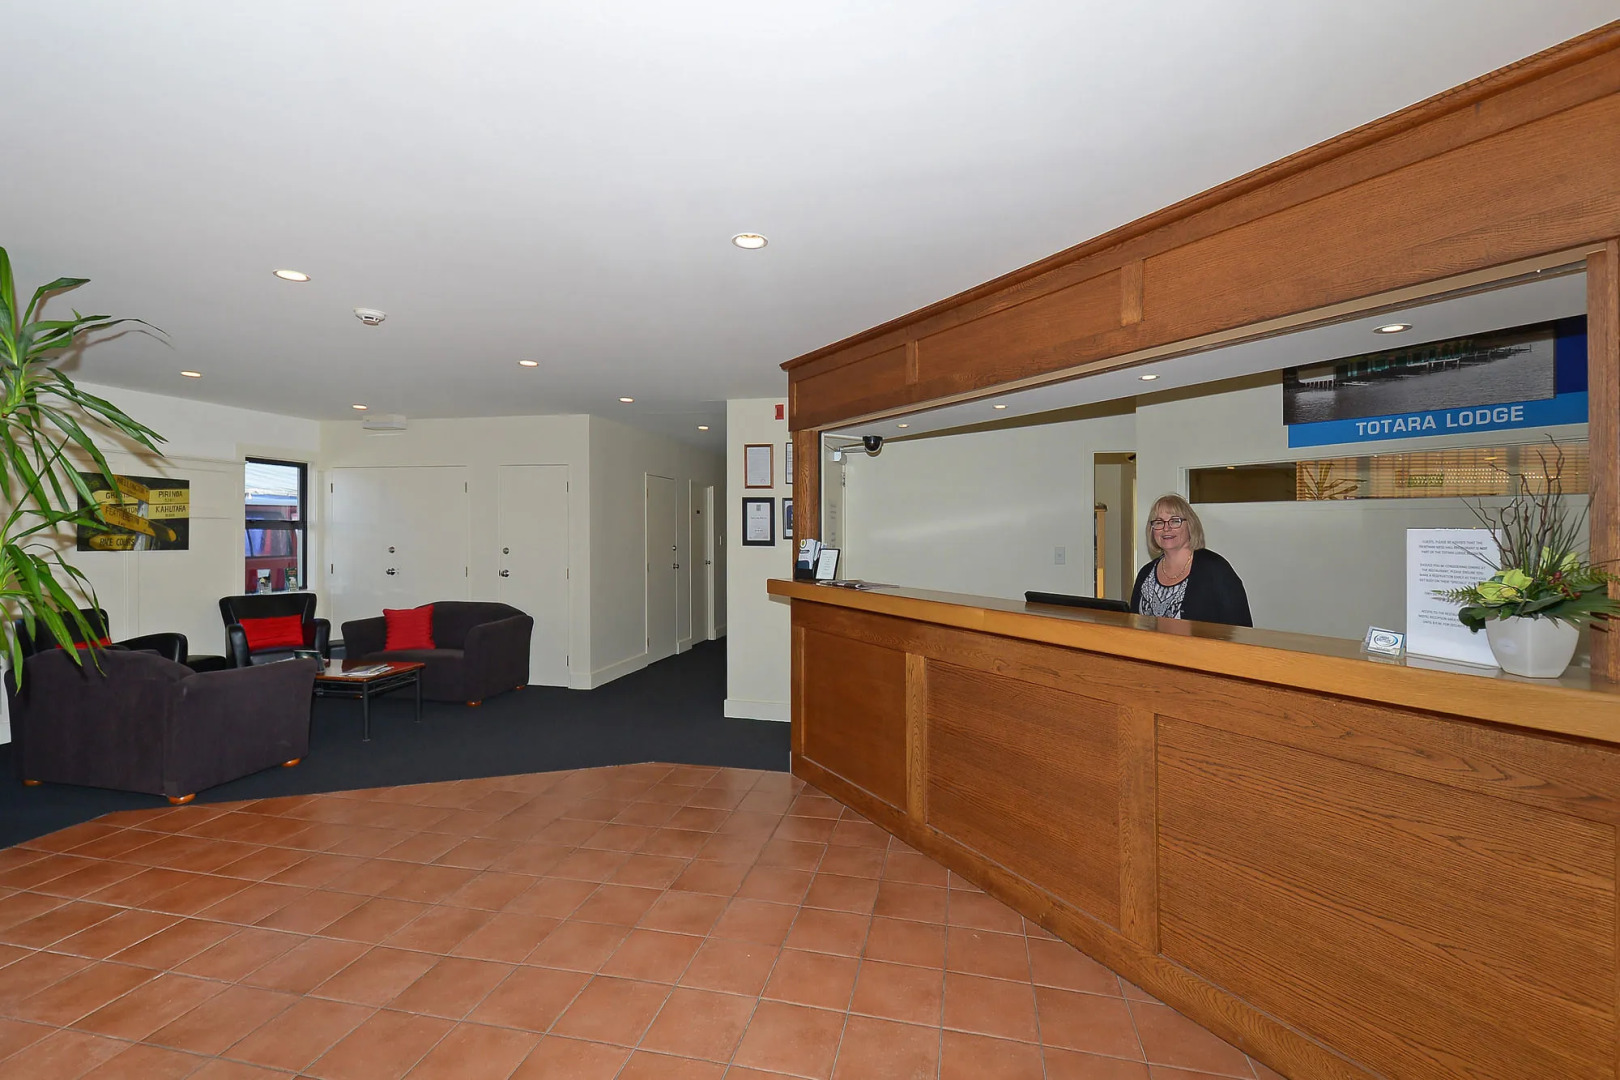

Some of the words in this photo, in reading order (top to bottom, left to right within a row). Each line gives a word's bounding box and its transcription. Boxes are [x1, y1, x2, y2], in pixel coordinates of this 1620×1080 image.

[1356, 415, 1436, 436] TOTARA
[1446, 406, 1524, 428] LODGE
[156, 505, 186, 513] KAHUTARA
